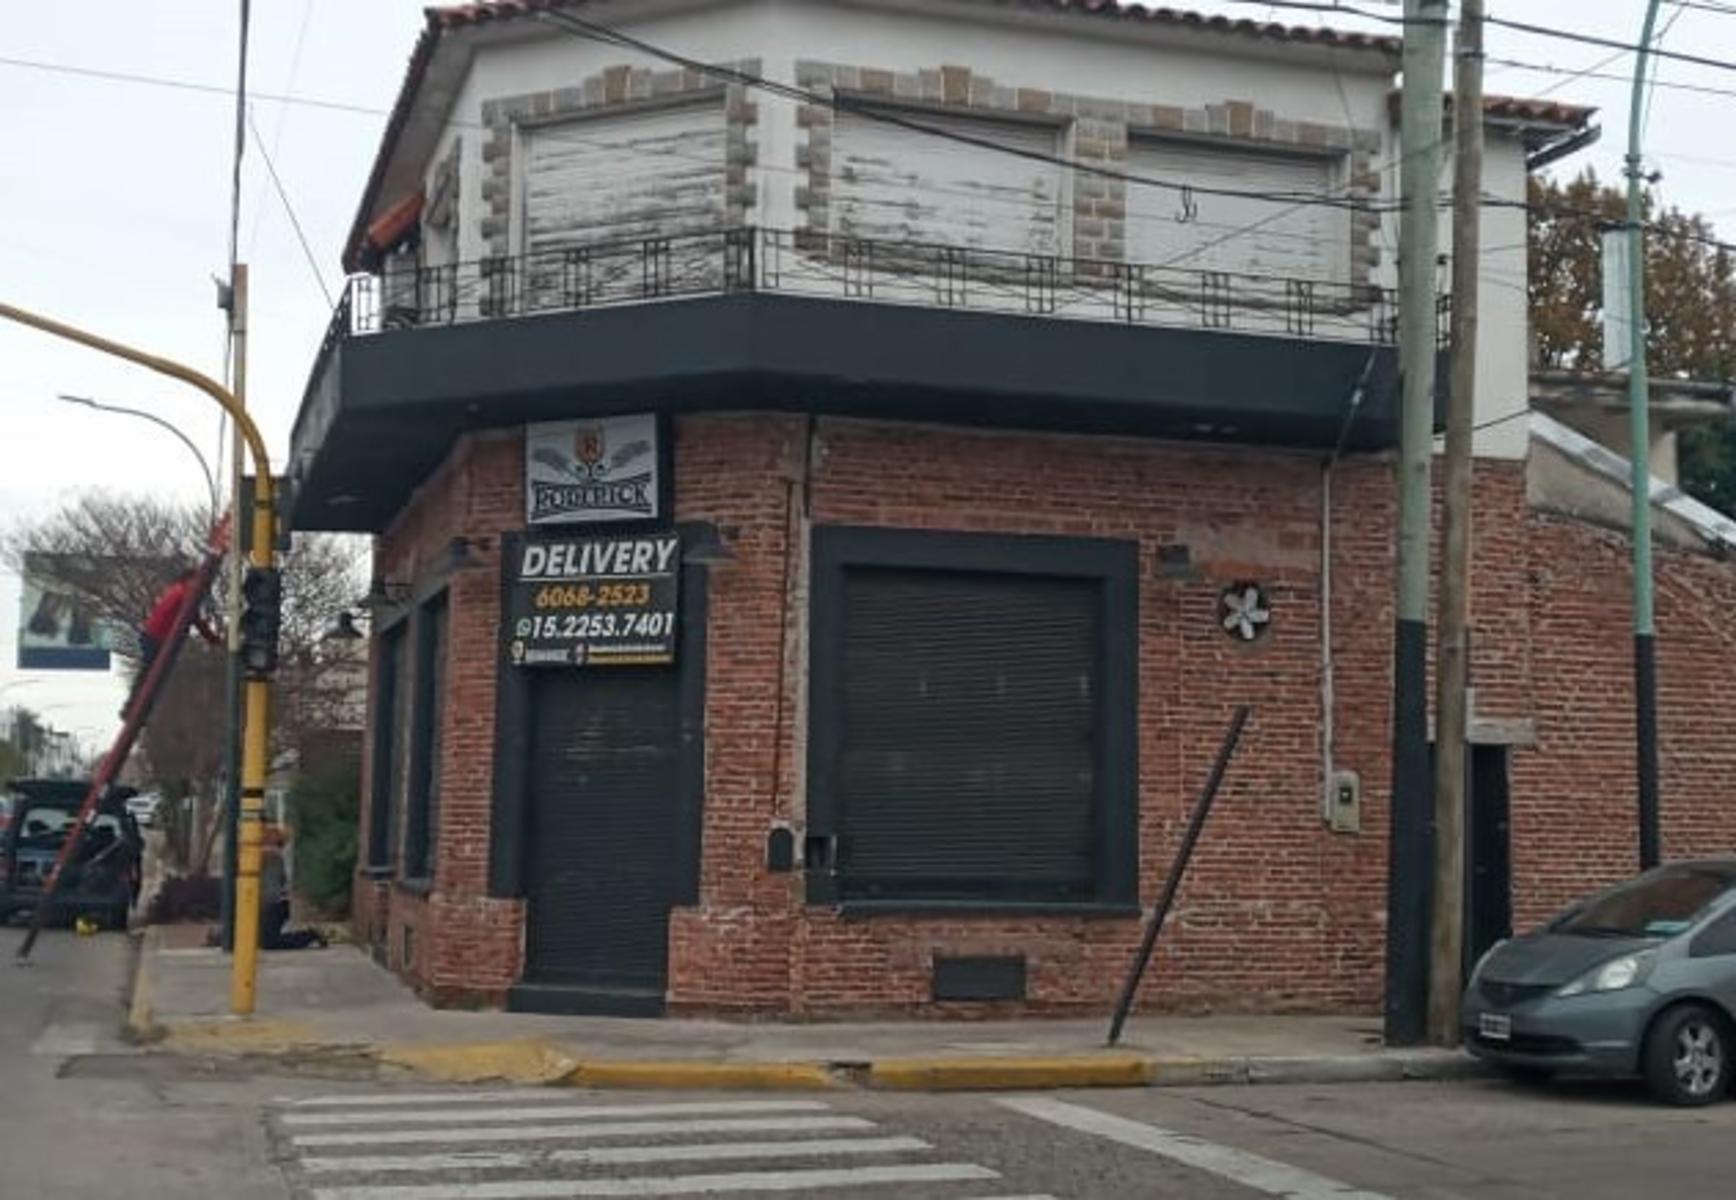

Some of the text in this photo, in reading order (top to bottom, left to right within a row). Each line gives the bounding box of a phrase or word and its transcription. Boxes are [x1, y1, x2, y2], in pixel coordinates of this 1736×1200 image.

[522, 539, 678, 576] DELIVERY
[536, 585, 650, 607] 6068-2523
[532, 612, 674, 638] 15.2253.7401
